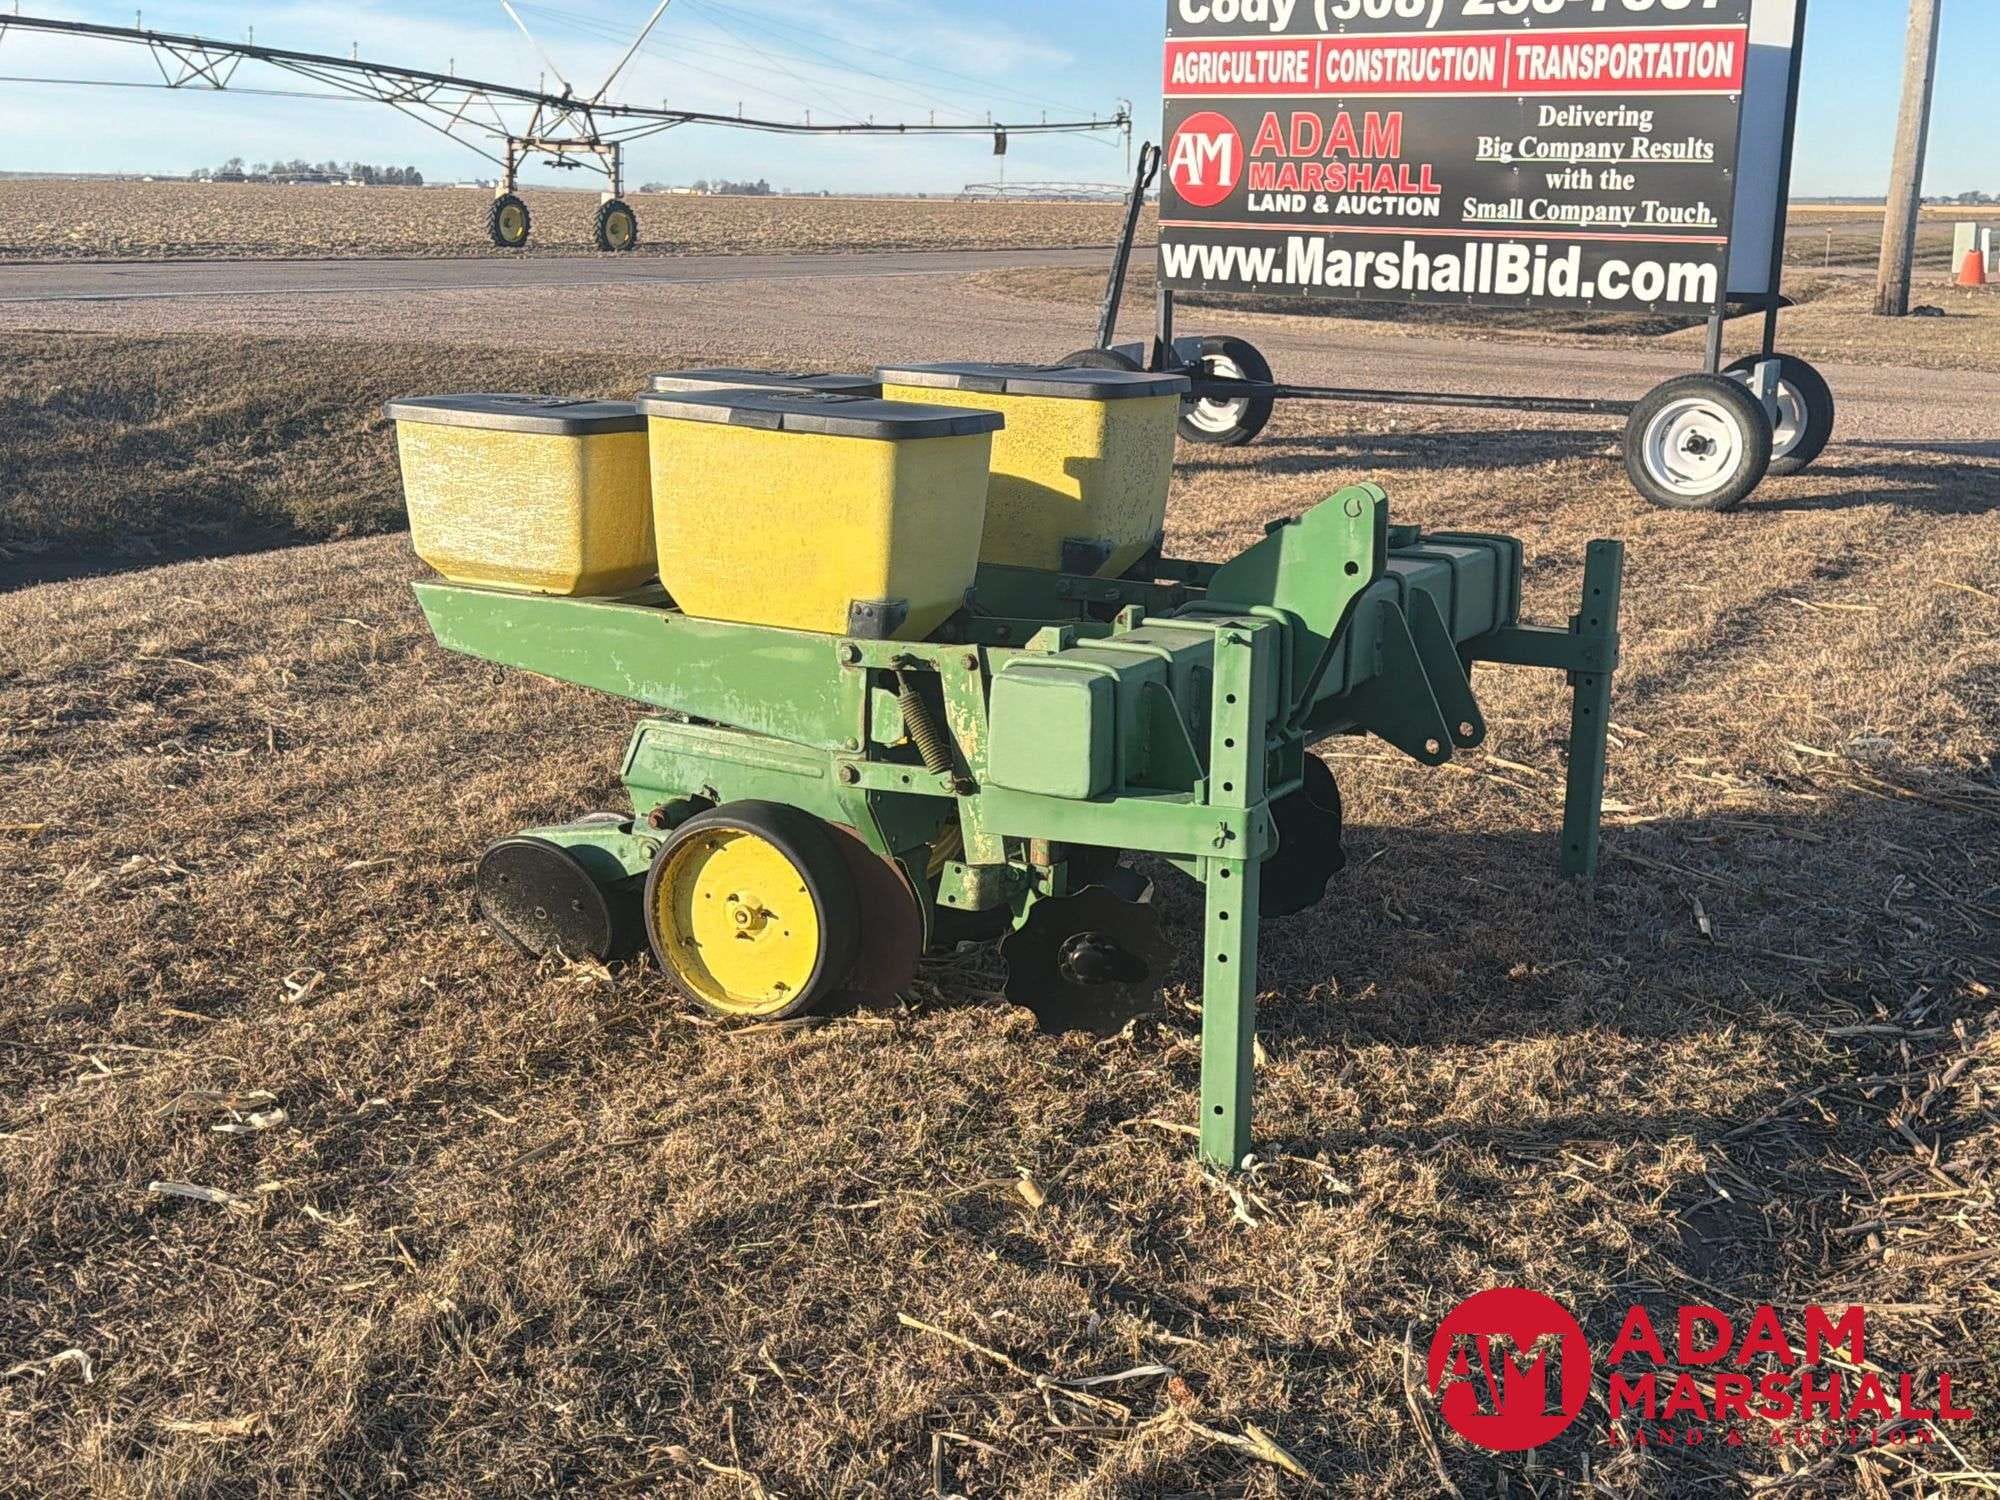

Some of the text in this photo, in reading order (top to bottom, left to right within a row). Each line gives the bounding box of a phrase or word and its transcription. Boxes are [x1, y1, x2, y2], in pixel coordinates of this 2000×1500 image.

[1171, 41, 1735, 84] AGRICULTURE CONSTRUCTION TRANSPORTATION
[1538, 105, 1654, 132] Delivering
[1250, 111, 1403, 159] ADAM
[1476, 136, 1715, 164] Big Company Results
[1169, 132, 1233, 187] AM
[1248, 162, 1442, 195] MARSHALL
[1546, 168, 1636, 191] with the
[1247, 193, 1441, 217] LAND & AUCTION
[1463, 197, 1719, 227] Small Company Touch.
[1161, 236, 1719, 304] www.MarshallBid.com
